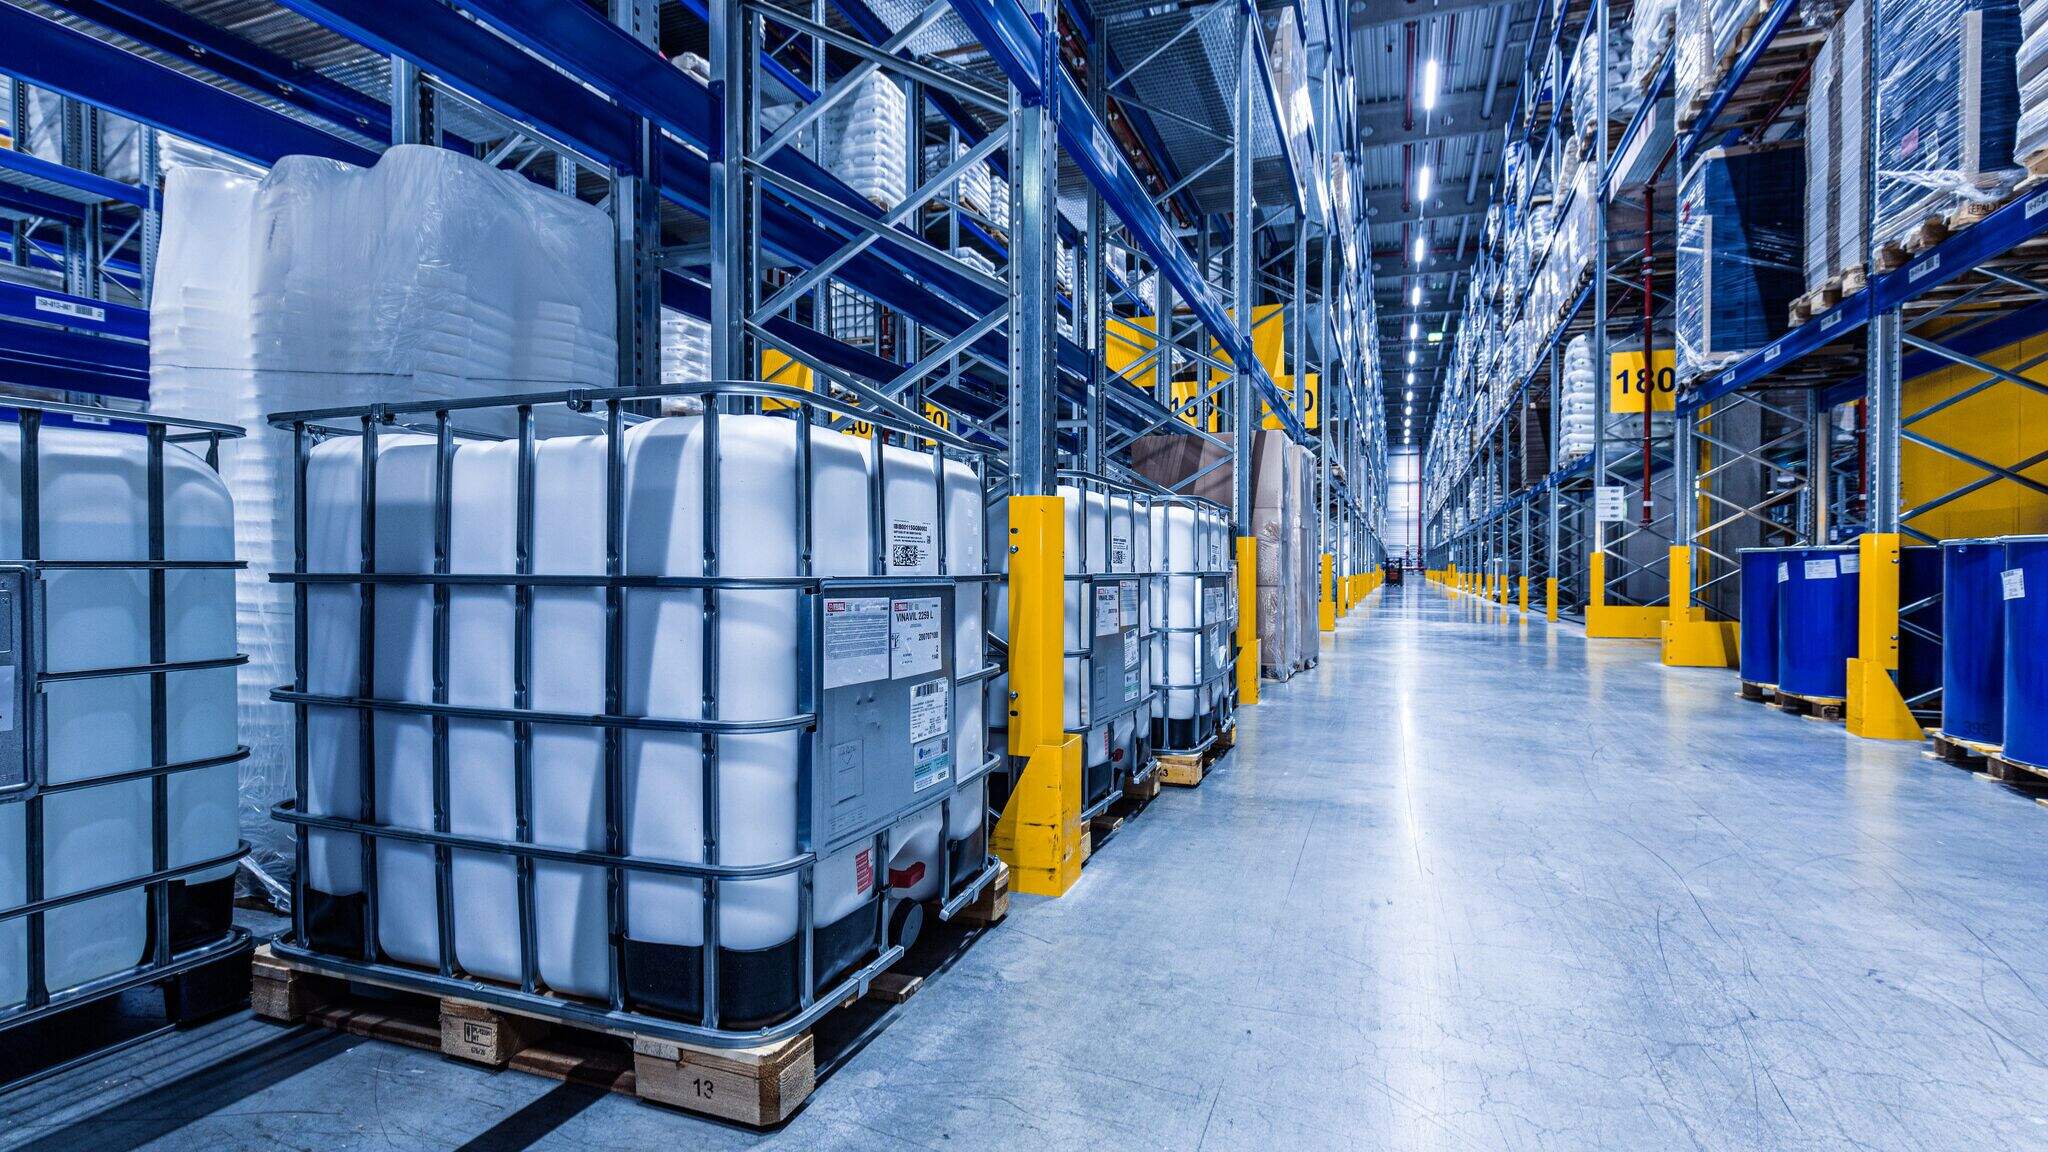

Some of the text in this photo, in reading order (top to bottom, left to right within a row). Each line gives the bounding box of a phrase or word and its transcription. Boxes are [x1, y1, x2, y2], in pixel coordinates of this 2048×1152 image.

[1616, 366, 1676, 394] 180
[896, 612, 917, 622] VINAVIL
[693, 1078, 714, 1099] 13
